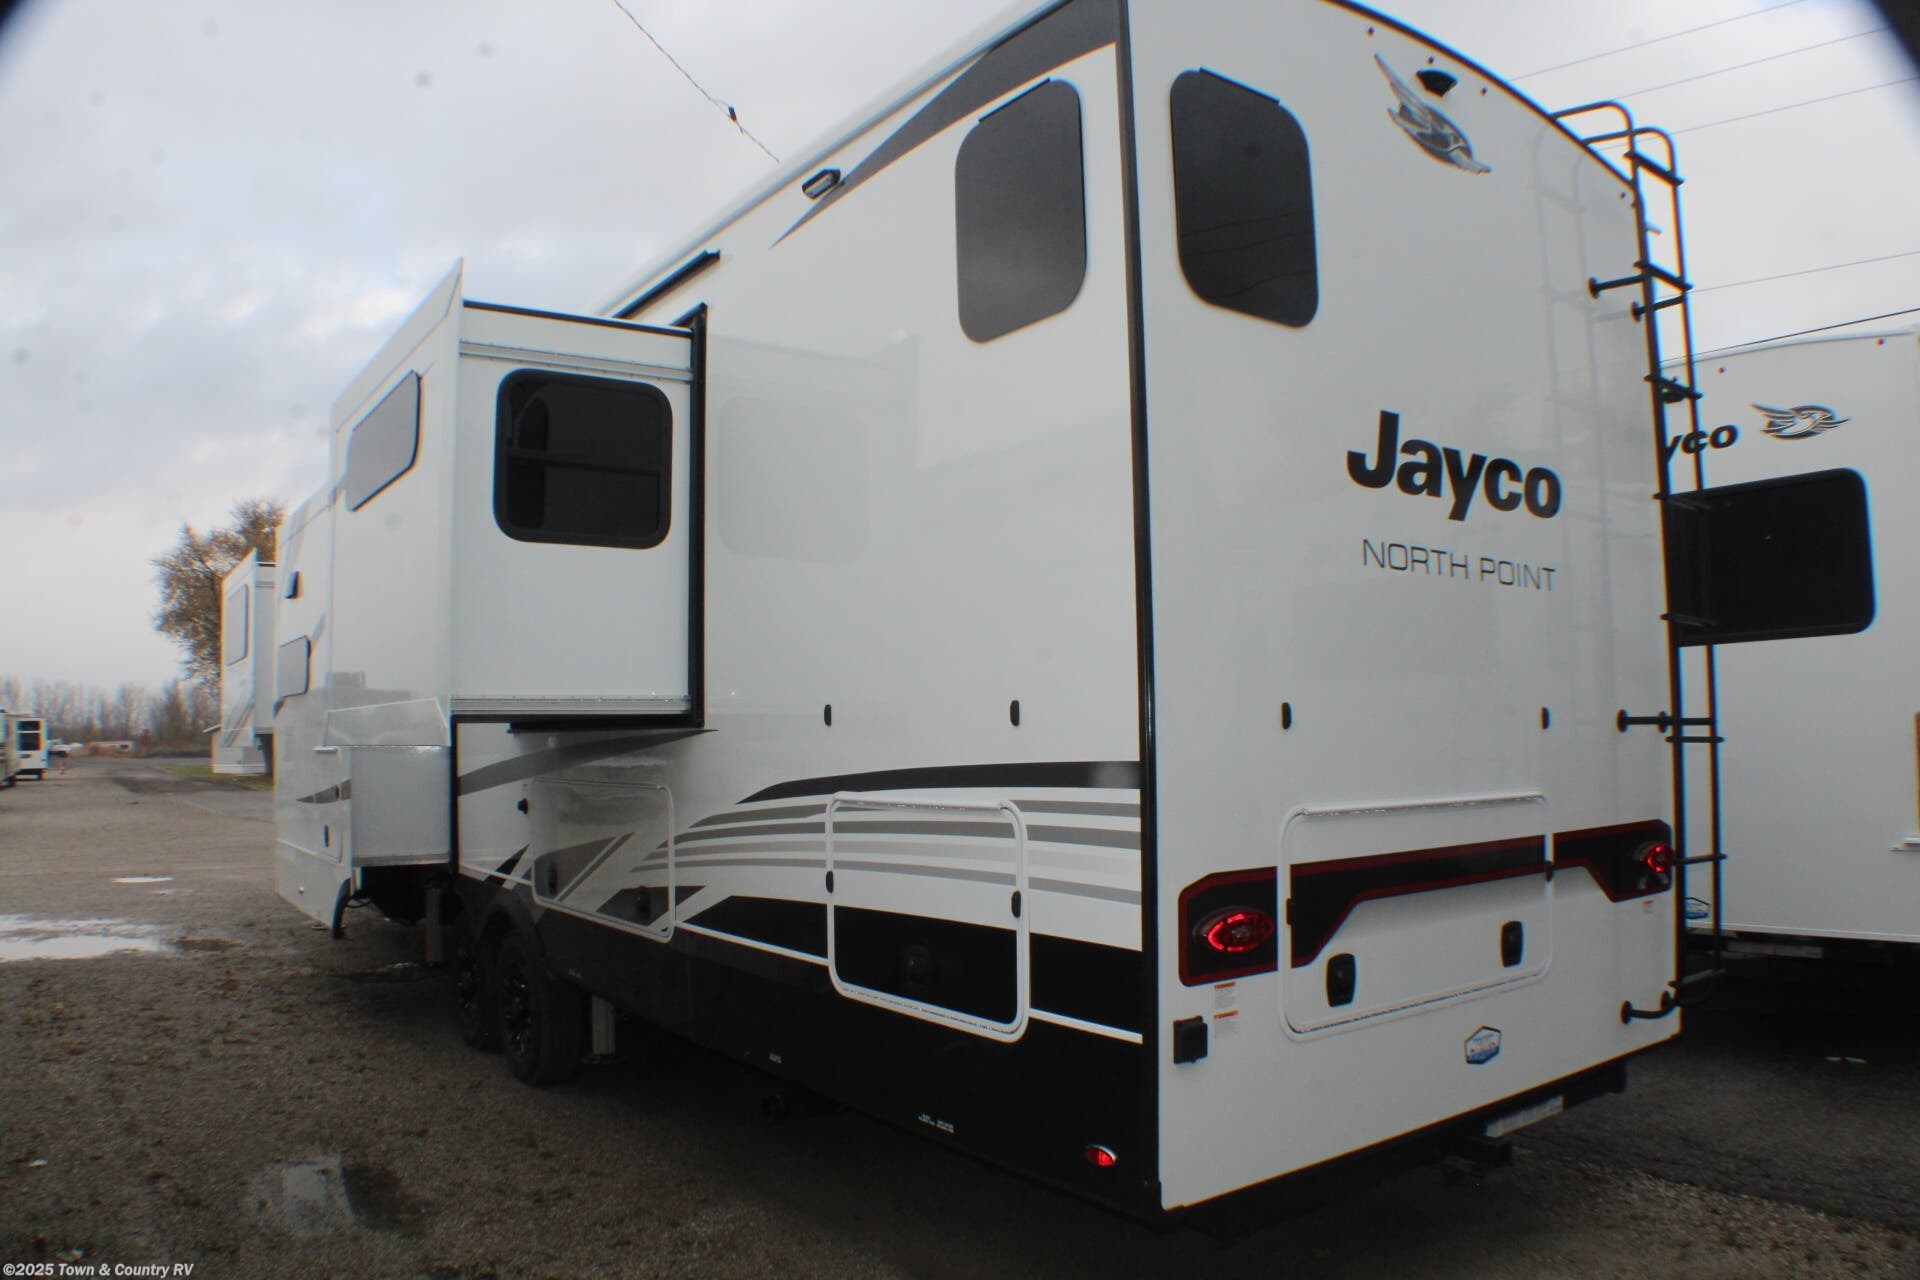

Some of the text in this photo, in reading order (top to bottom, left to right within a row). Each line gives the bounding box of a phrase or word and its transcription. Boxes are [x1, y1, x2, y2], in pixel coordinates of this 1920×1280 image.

[1347, 409, 1562, 522] Jayco
[1362, 538, 1556, 592] NORTH POINT
